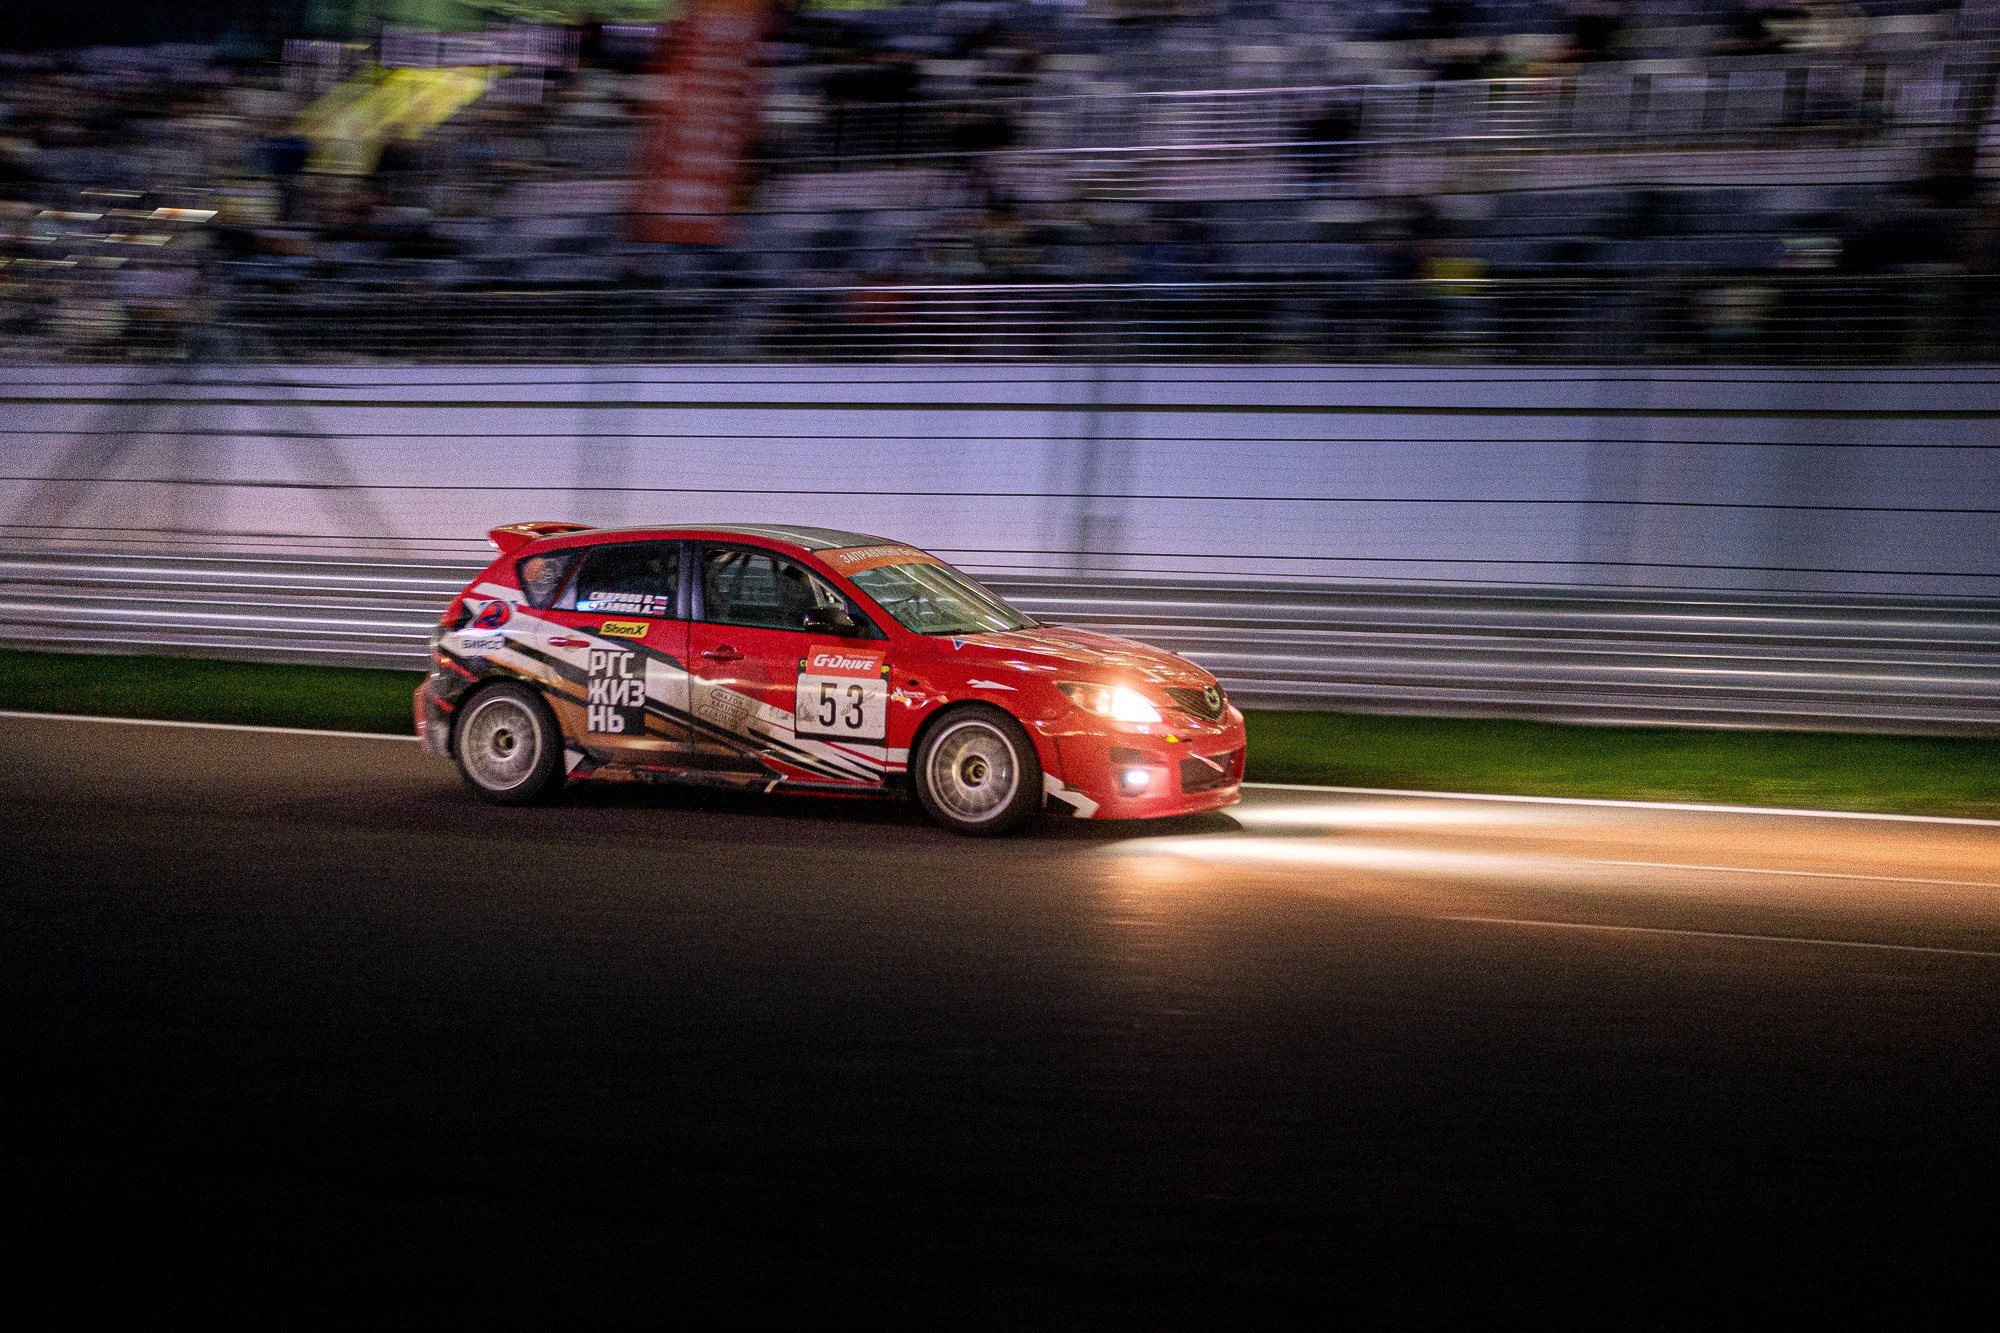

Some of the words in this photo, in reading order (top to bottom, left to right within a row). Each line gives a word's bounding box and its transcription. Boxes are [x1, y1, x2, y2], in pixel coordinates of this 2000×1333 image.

[604, 622, 646, 636] ShonX
[588, 651, 635, 679] РГС
[588, 678, 646, 707] ЖИЗ
[818, 682, 864, 729] 53
[588, 704, 626, 733] НЬ
